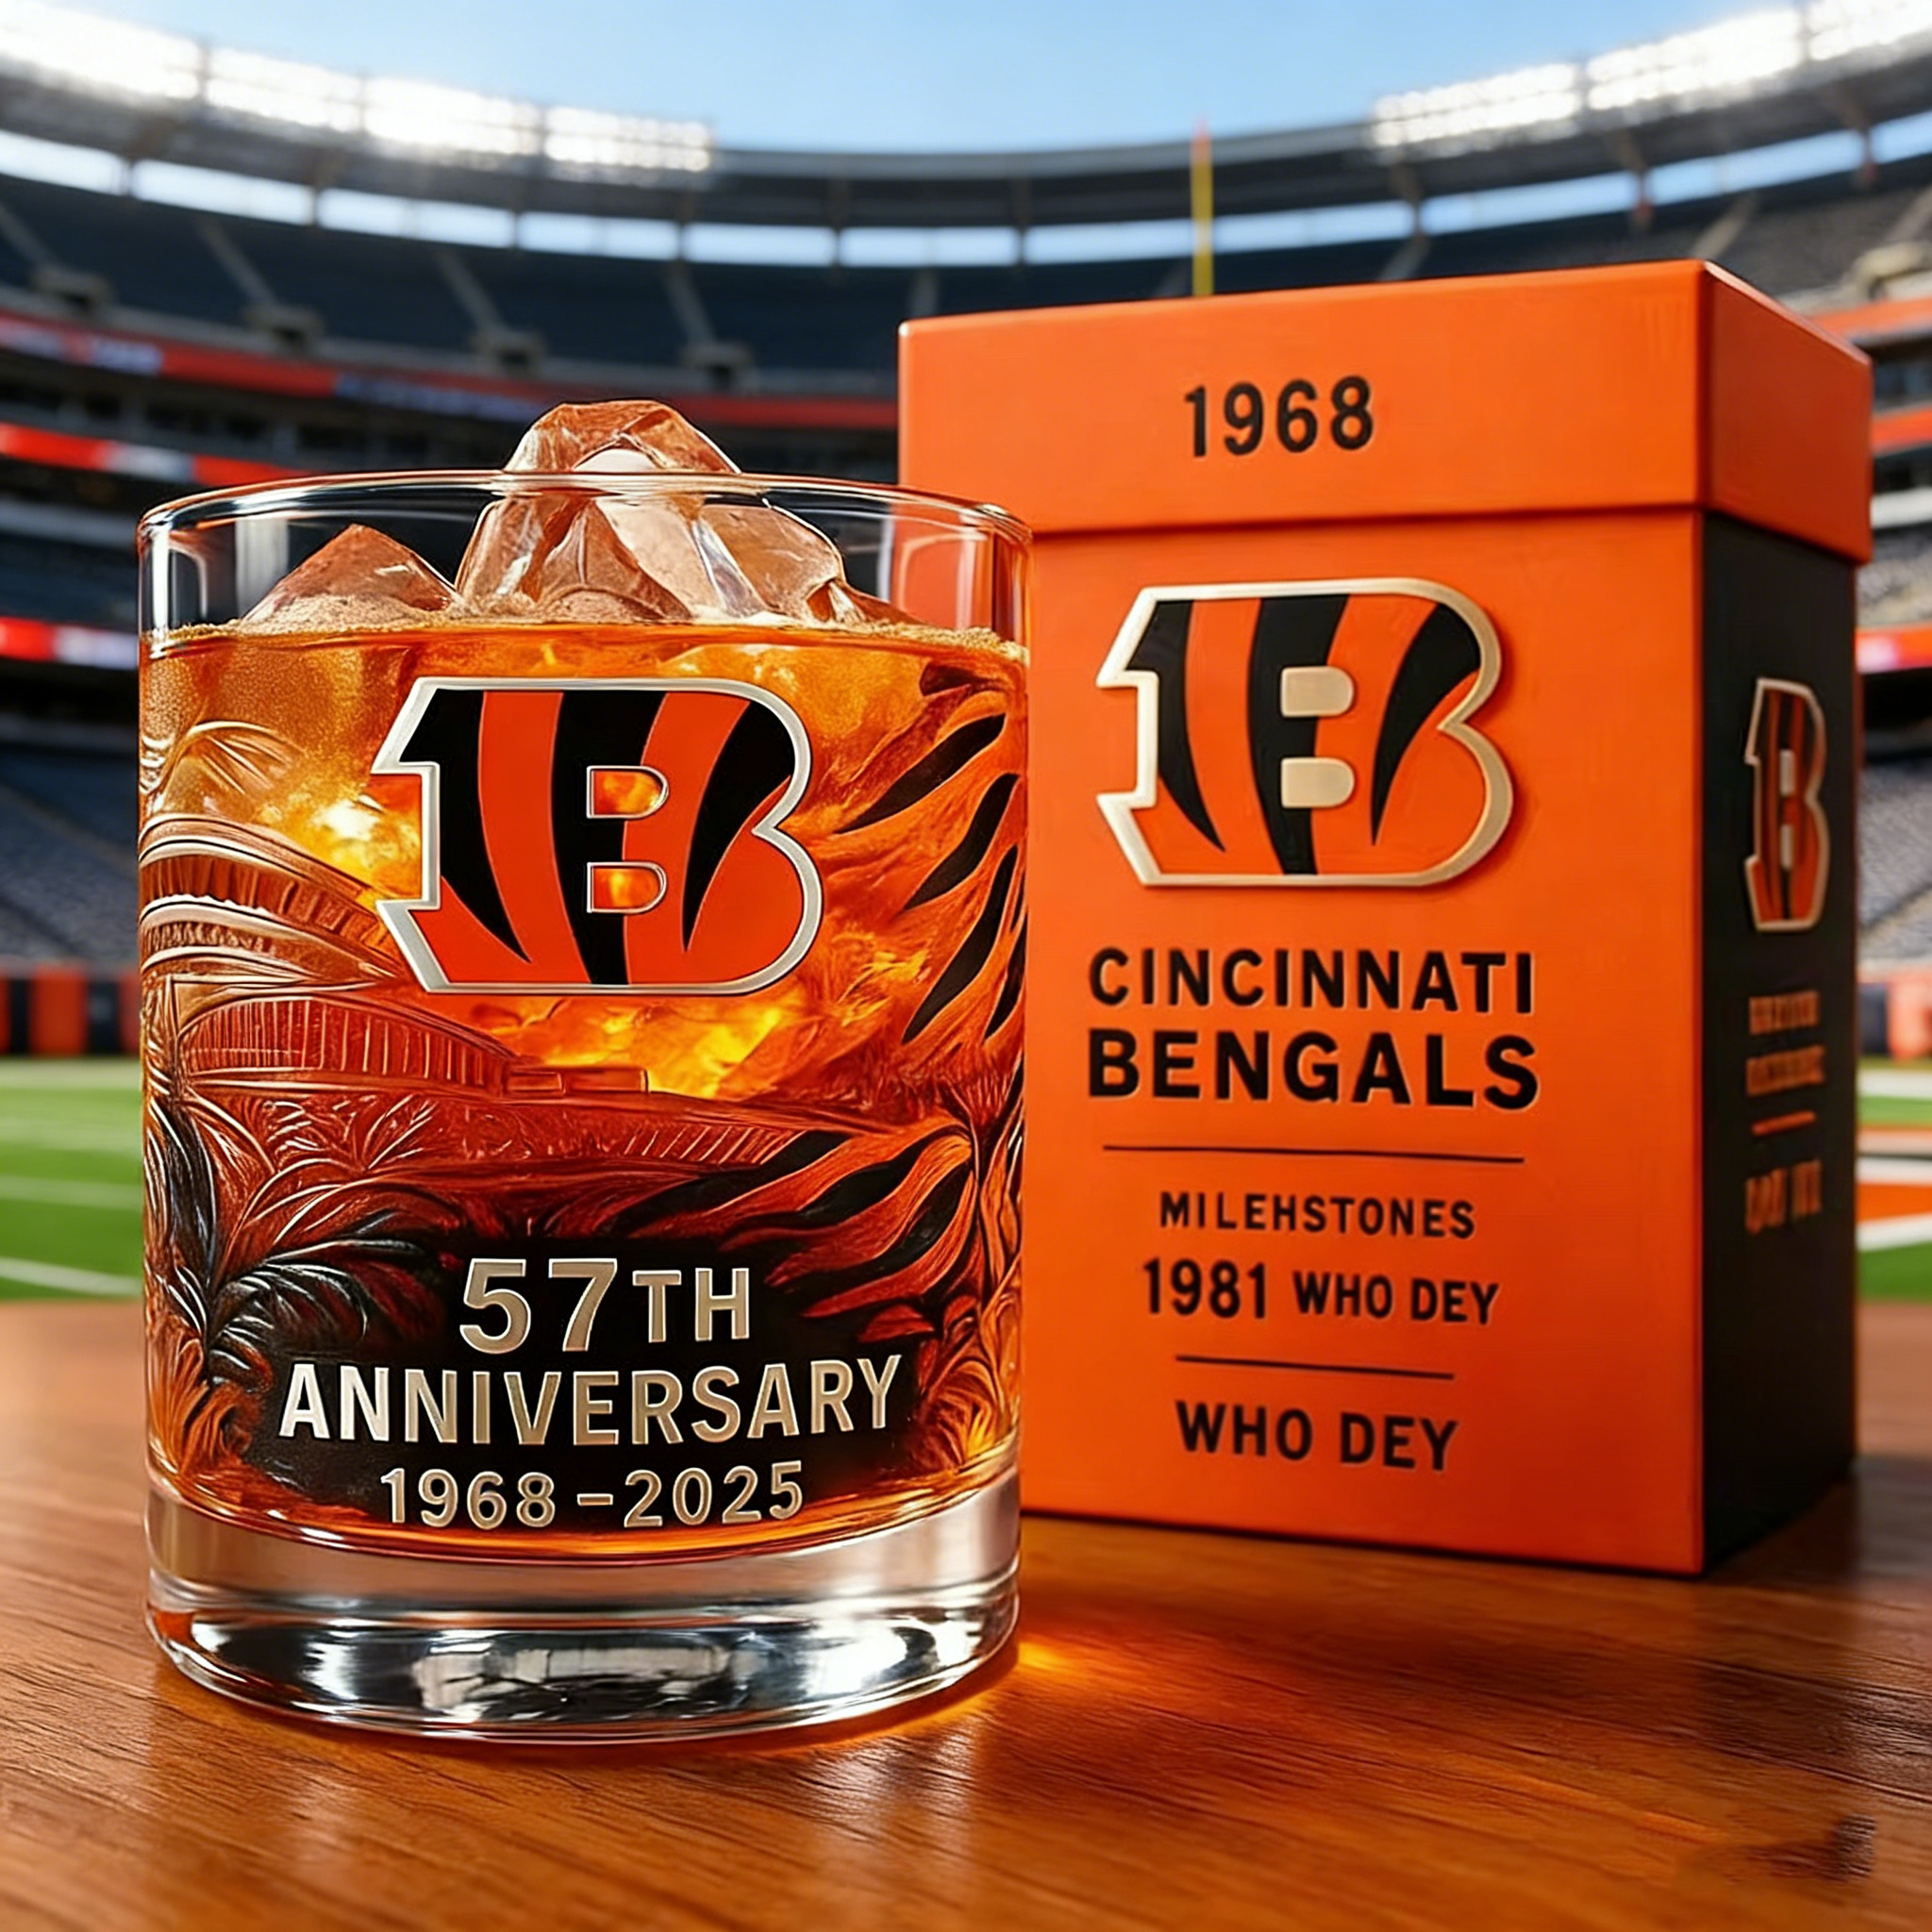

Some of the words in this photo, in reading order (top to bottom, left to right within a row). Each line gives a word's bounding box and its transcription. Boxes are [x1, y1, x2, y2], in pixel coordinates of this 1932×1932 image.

[1185, 375, 1374, 458] 1968
[1088, 946, 1535, 1014] CINCINNATI
[1088, 1028, 1540, 1110] BENGALS
[1159, 1191, 1476, 1240] MILEHSTONES
[459, 1257, 751, 1354] 57TH
[1142, 1257, 1266, 1320] 1981
[1292, 1271, 1394, 1317] WHO
[1410, 1278, 1500, 1324] DEY
[278, 1354, 903, 1446] ANNIVERSARY
[1174, 1400, 1314, 1461] WHO
[1340, 1412, 1459, 1471] DEY
